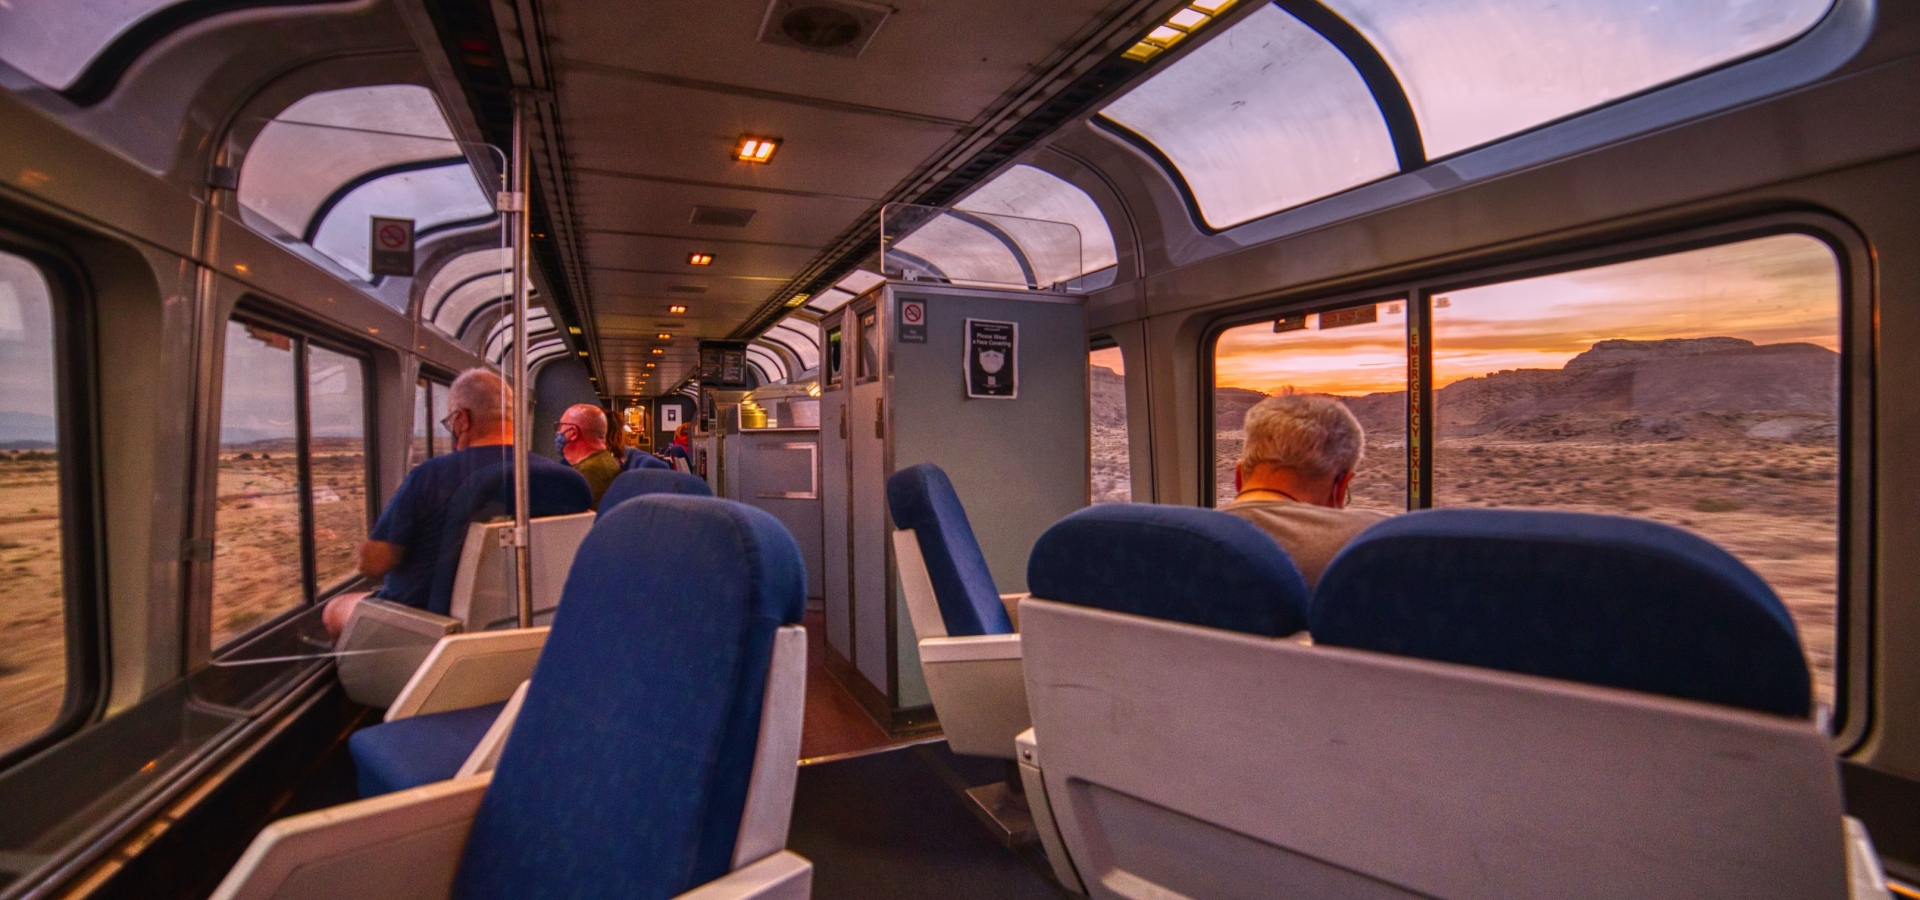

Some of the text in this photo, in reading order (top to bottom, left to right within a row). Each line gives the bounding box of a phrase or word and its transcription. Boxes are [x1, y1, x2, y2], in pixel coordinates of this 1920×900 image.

[988, 340, 1012, 348] Covering
[1411, 334, 1419, 492] EMERGENCY EXIT
